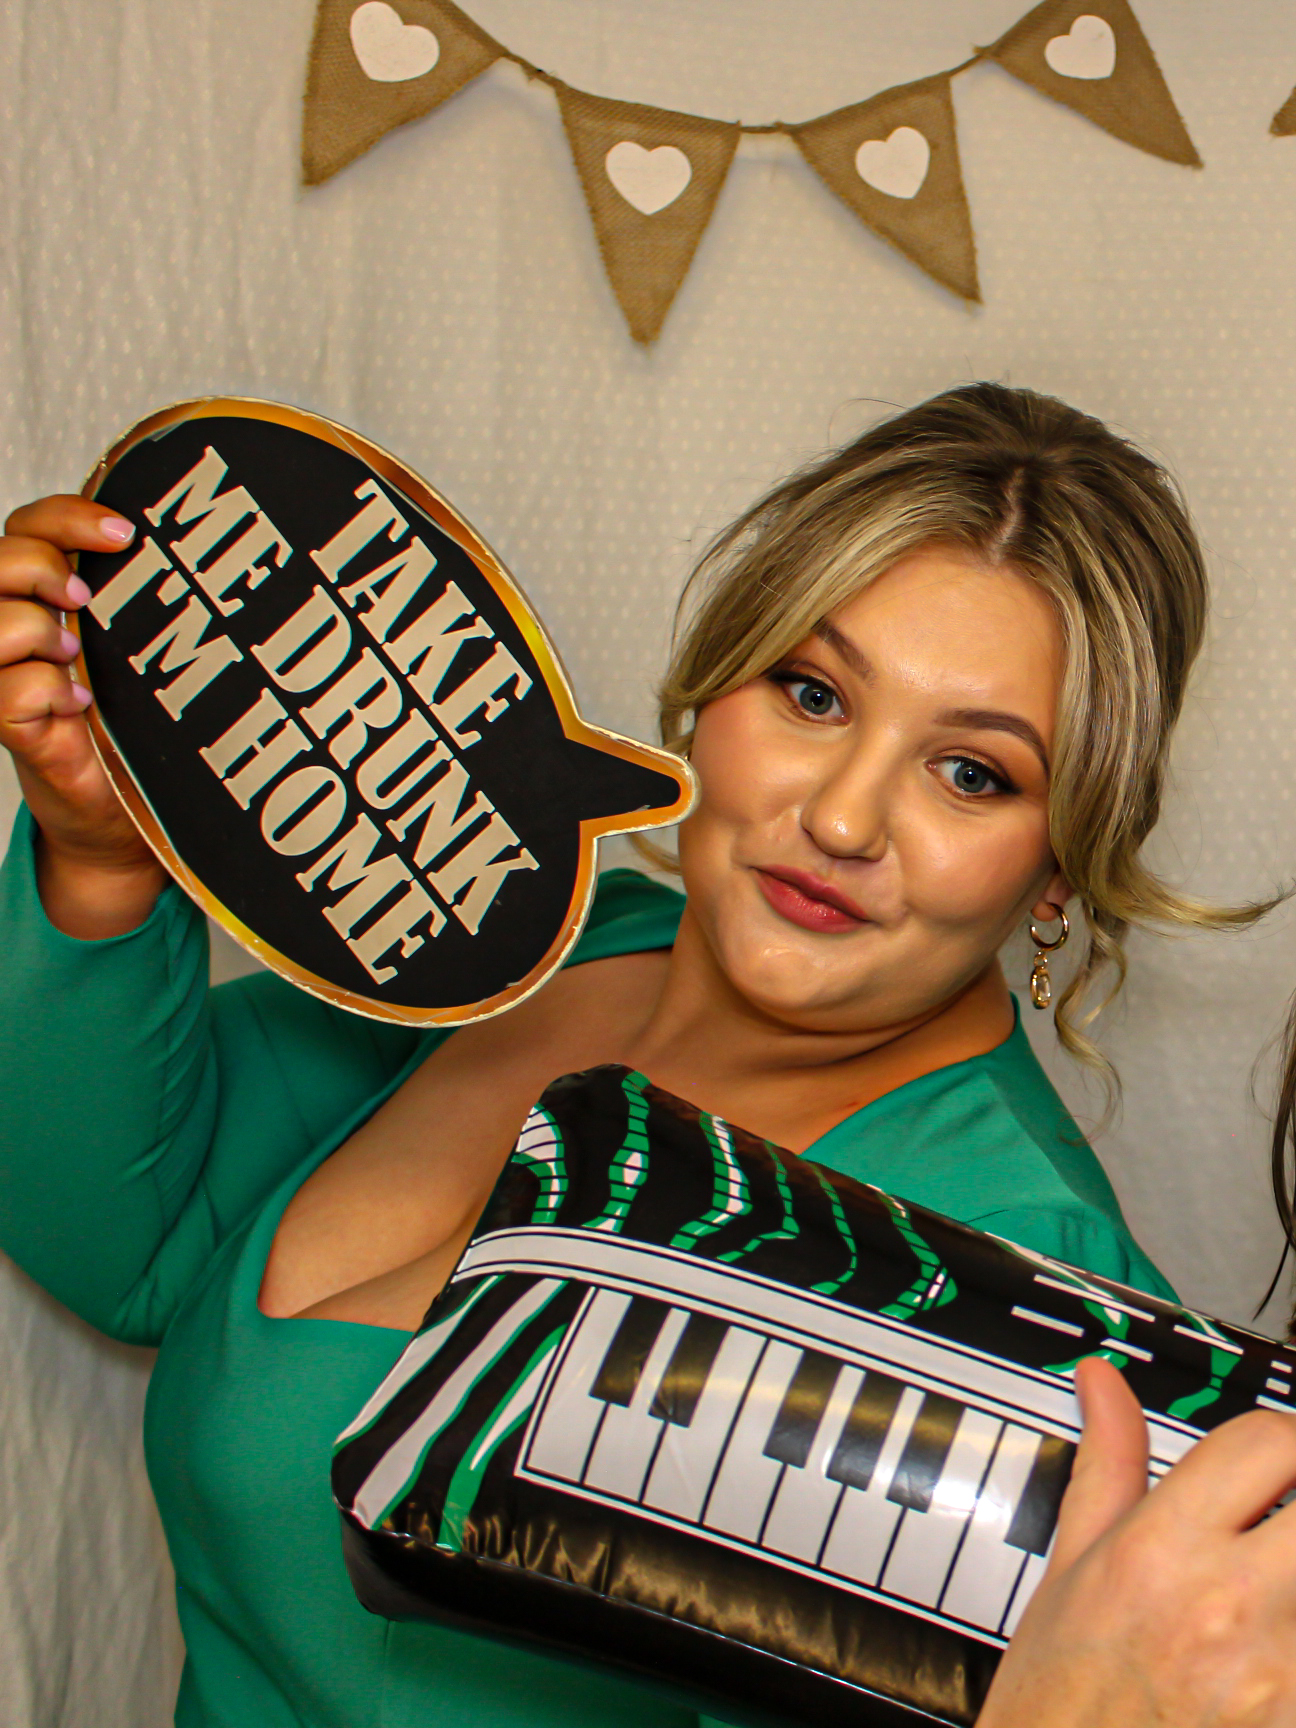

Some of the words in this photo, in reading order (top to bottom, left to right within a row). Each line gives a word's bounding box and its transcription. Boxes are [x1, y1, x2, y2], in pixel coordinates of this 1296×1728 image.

[86, 535, 244, 722] I'M
[198, 687, 449, 986] HOME
[143, 445, 293, 617] ME
[250, 584, 540, 936] DRUNK
[309, 478, 534, 750] TAKE
